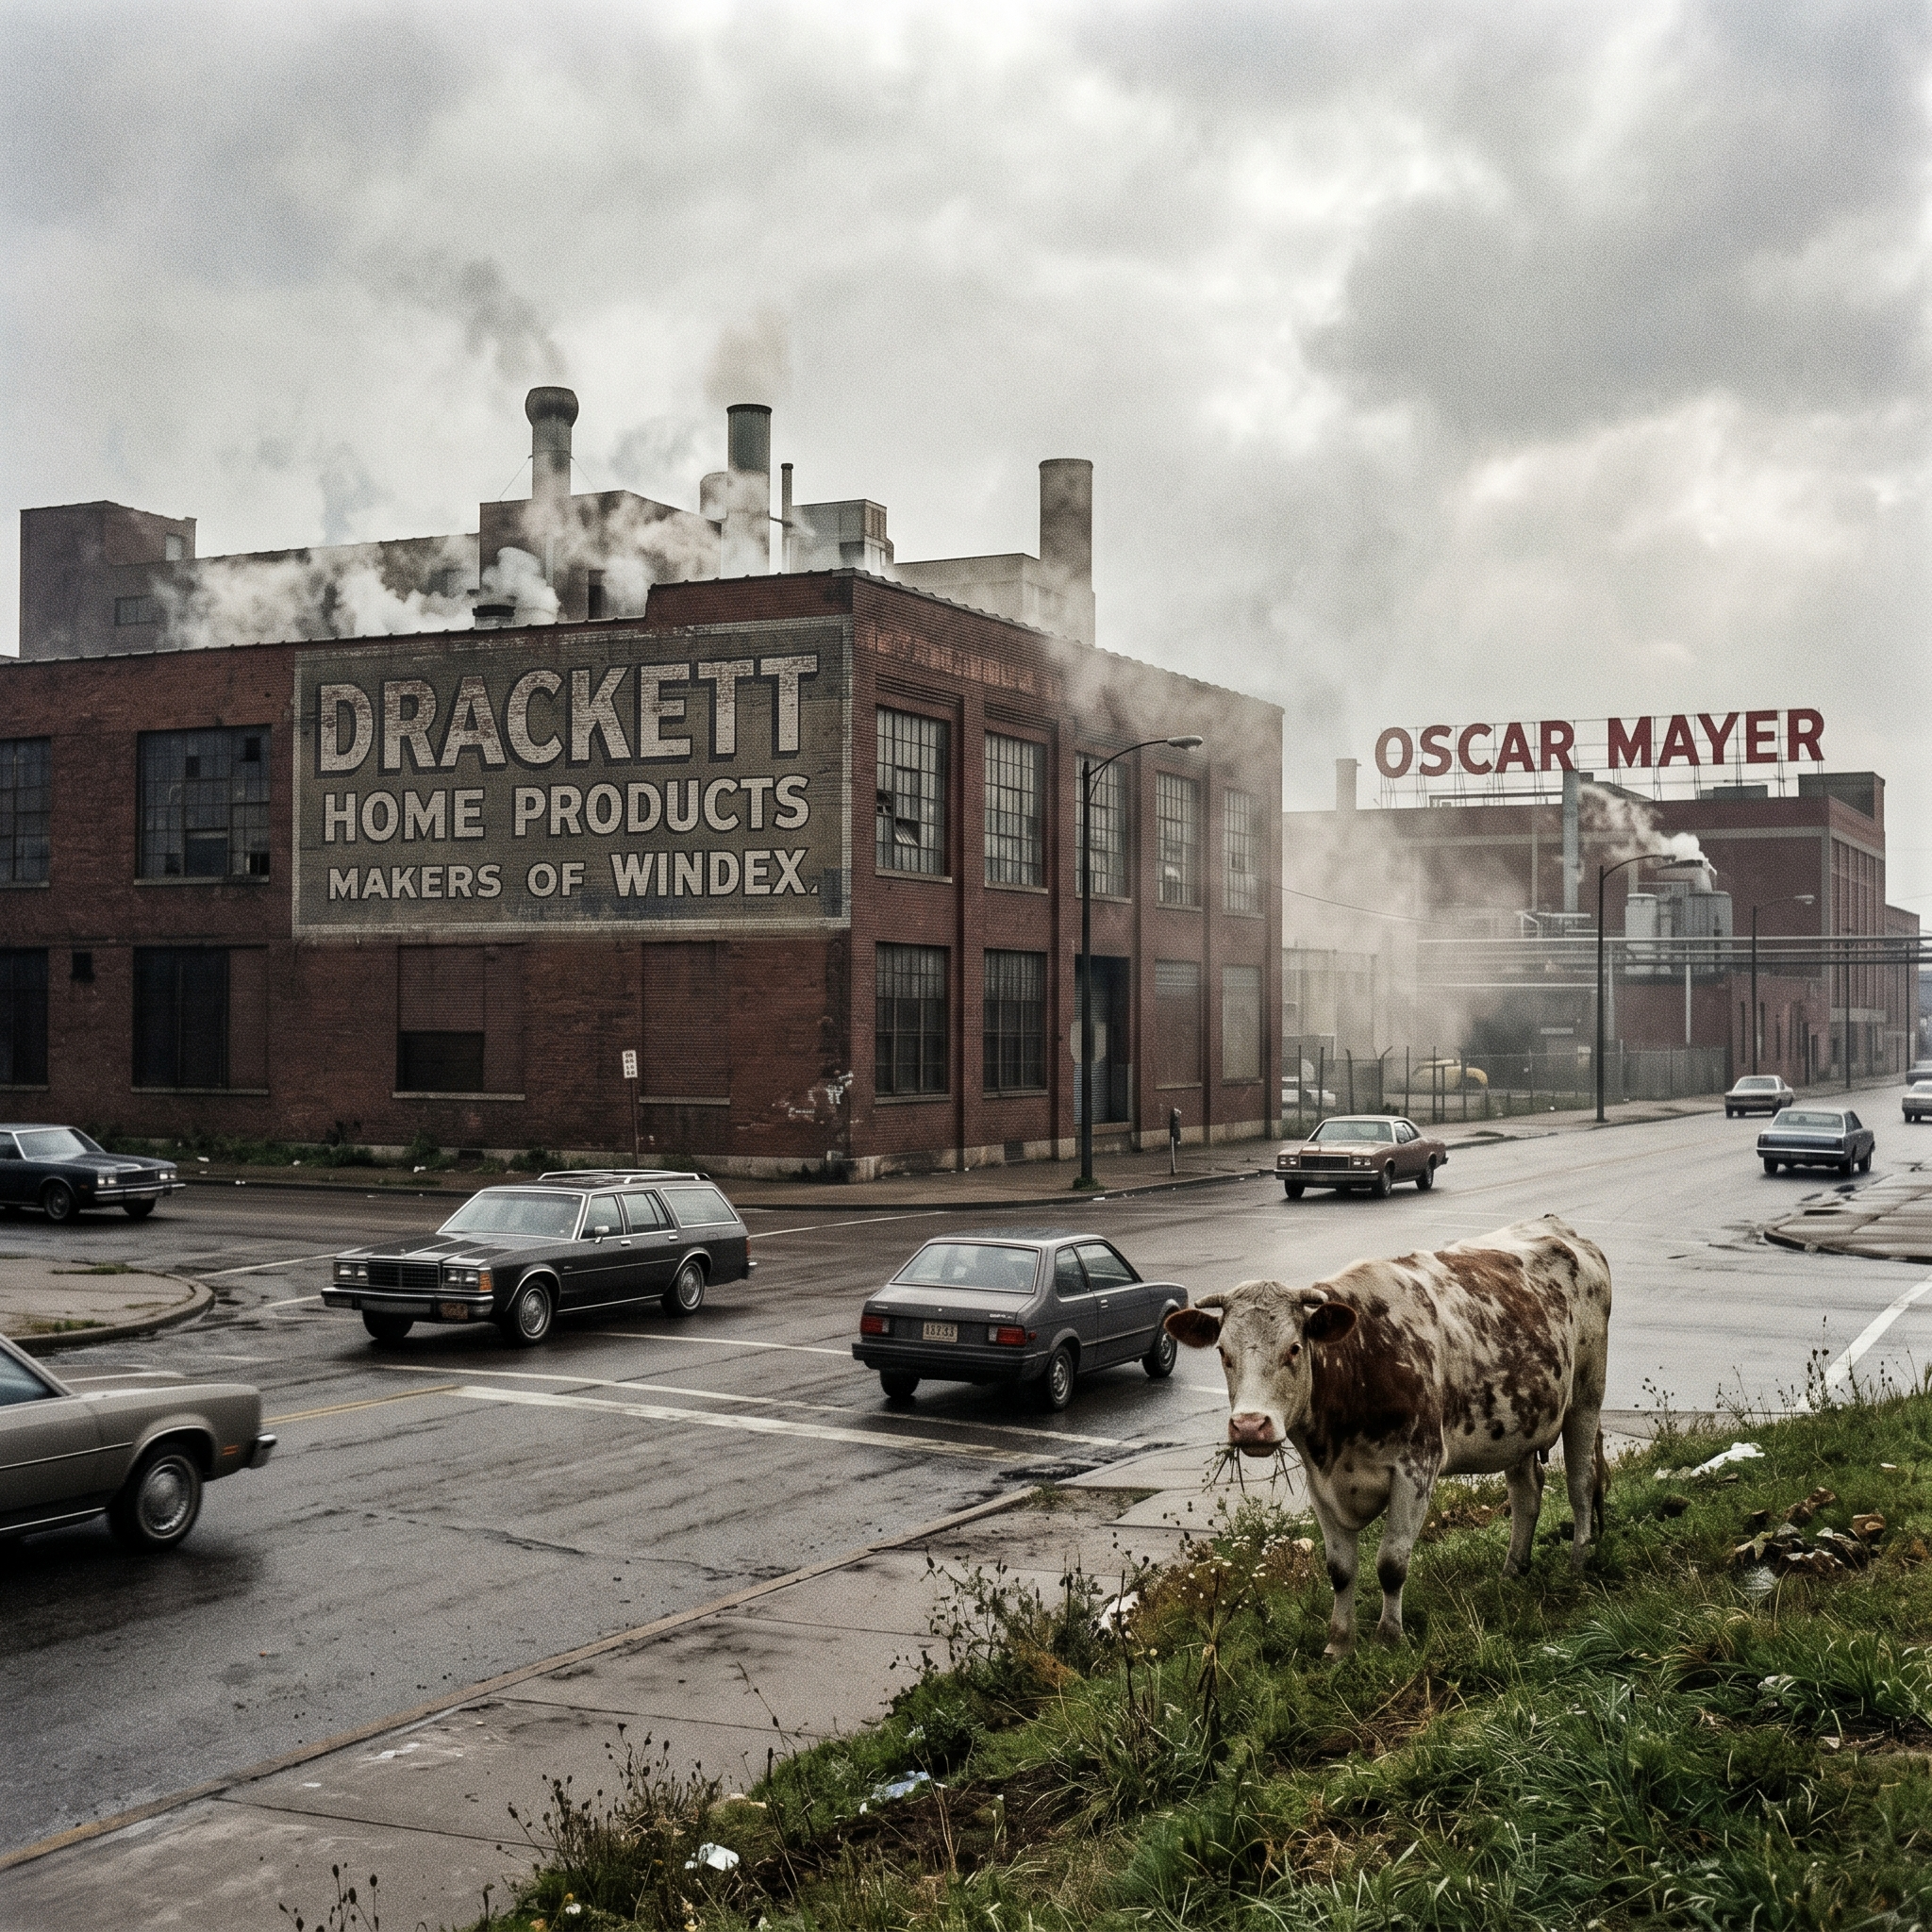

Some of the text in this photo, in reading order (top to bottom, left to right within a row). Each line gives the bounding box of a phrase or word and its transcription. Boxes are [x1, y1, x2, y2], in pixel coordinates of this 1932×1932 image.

[319, 654, 818, 773] DRACKETT
[1374, 708, 1825, 778] OSCAR MAYER
[324, 774, 811, 842] HOME PRODUCTS
[328, 864, 503, 901] MAKERS
[526, 862, 586, 897] OF
